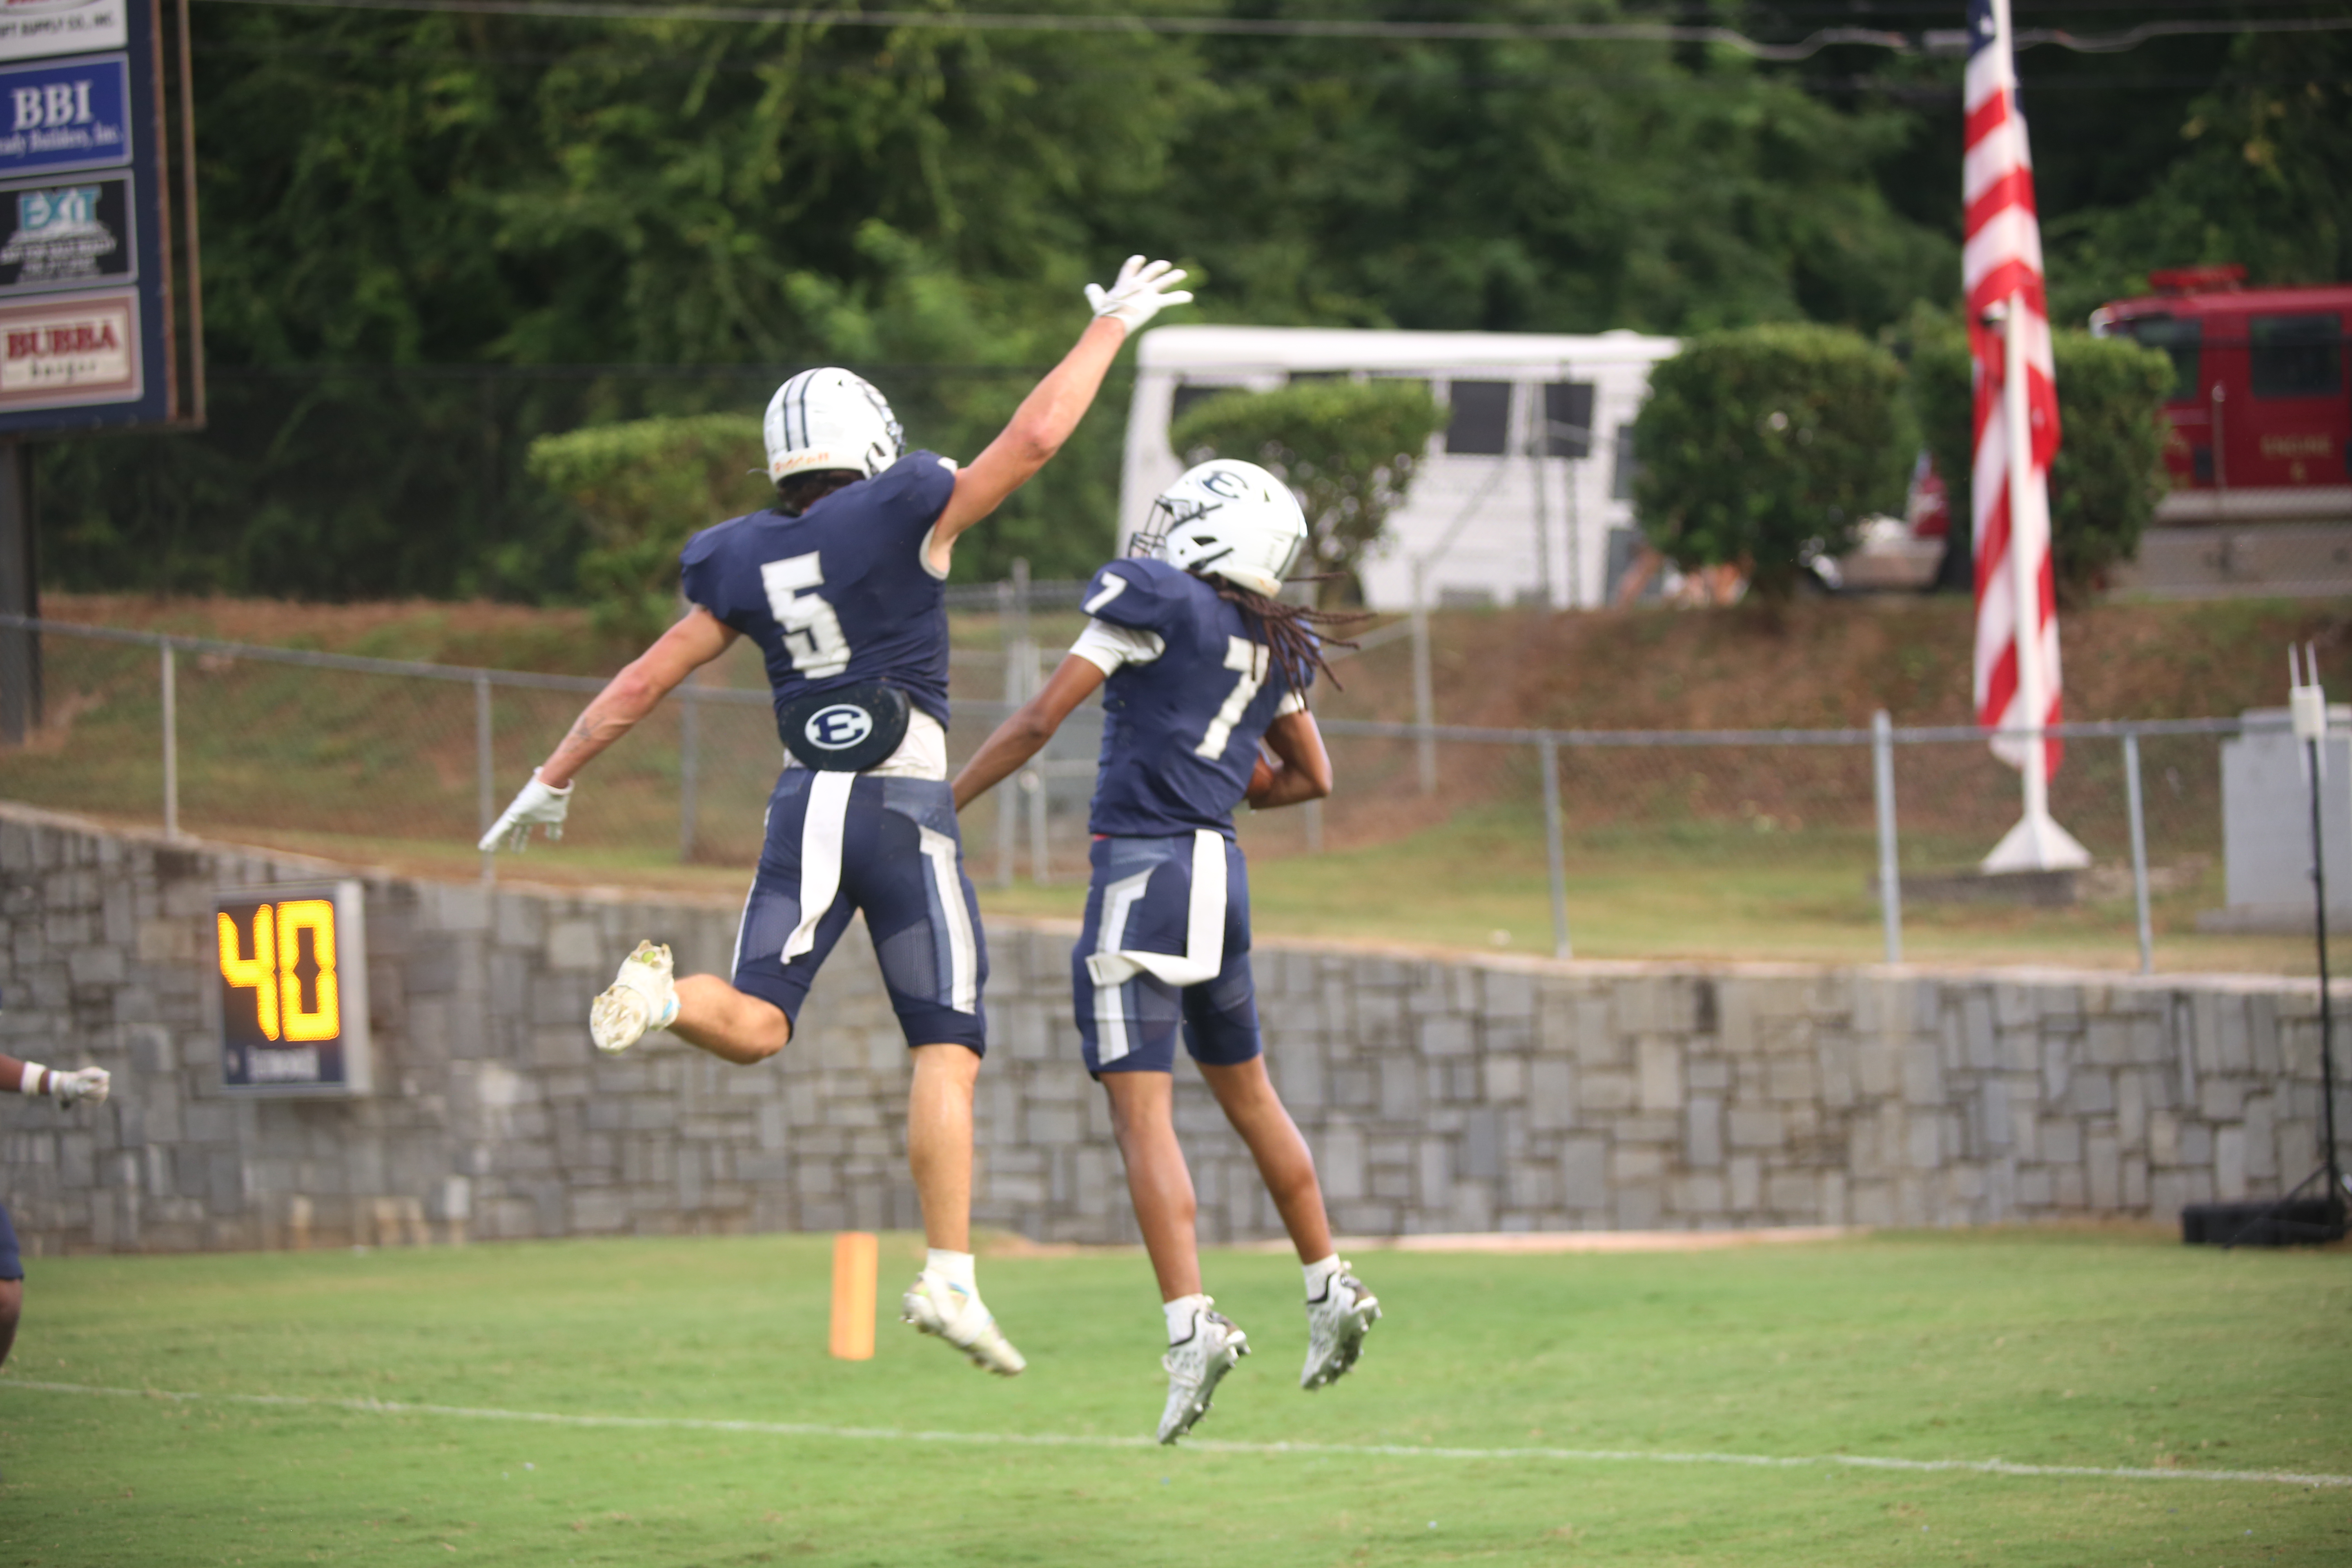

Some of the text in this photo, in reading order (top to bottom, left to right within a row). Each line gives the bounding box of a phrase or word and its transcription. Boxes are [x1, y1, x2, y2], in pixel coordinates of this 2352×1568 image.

[11, 80, 93, 131] BBI
[20, 185, 101, 231] EXIT
[7, 320, 118, 359] BUBBA
[760, 551, 851, 679] 5
[1084, 572, 1127, 613] 7
[1195, 635, 1270, 760] 7
[811, 708, 867, 746] E
[218, 900, 339, 1042] 40
